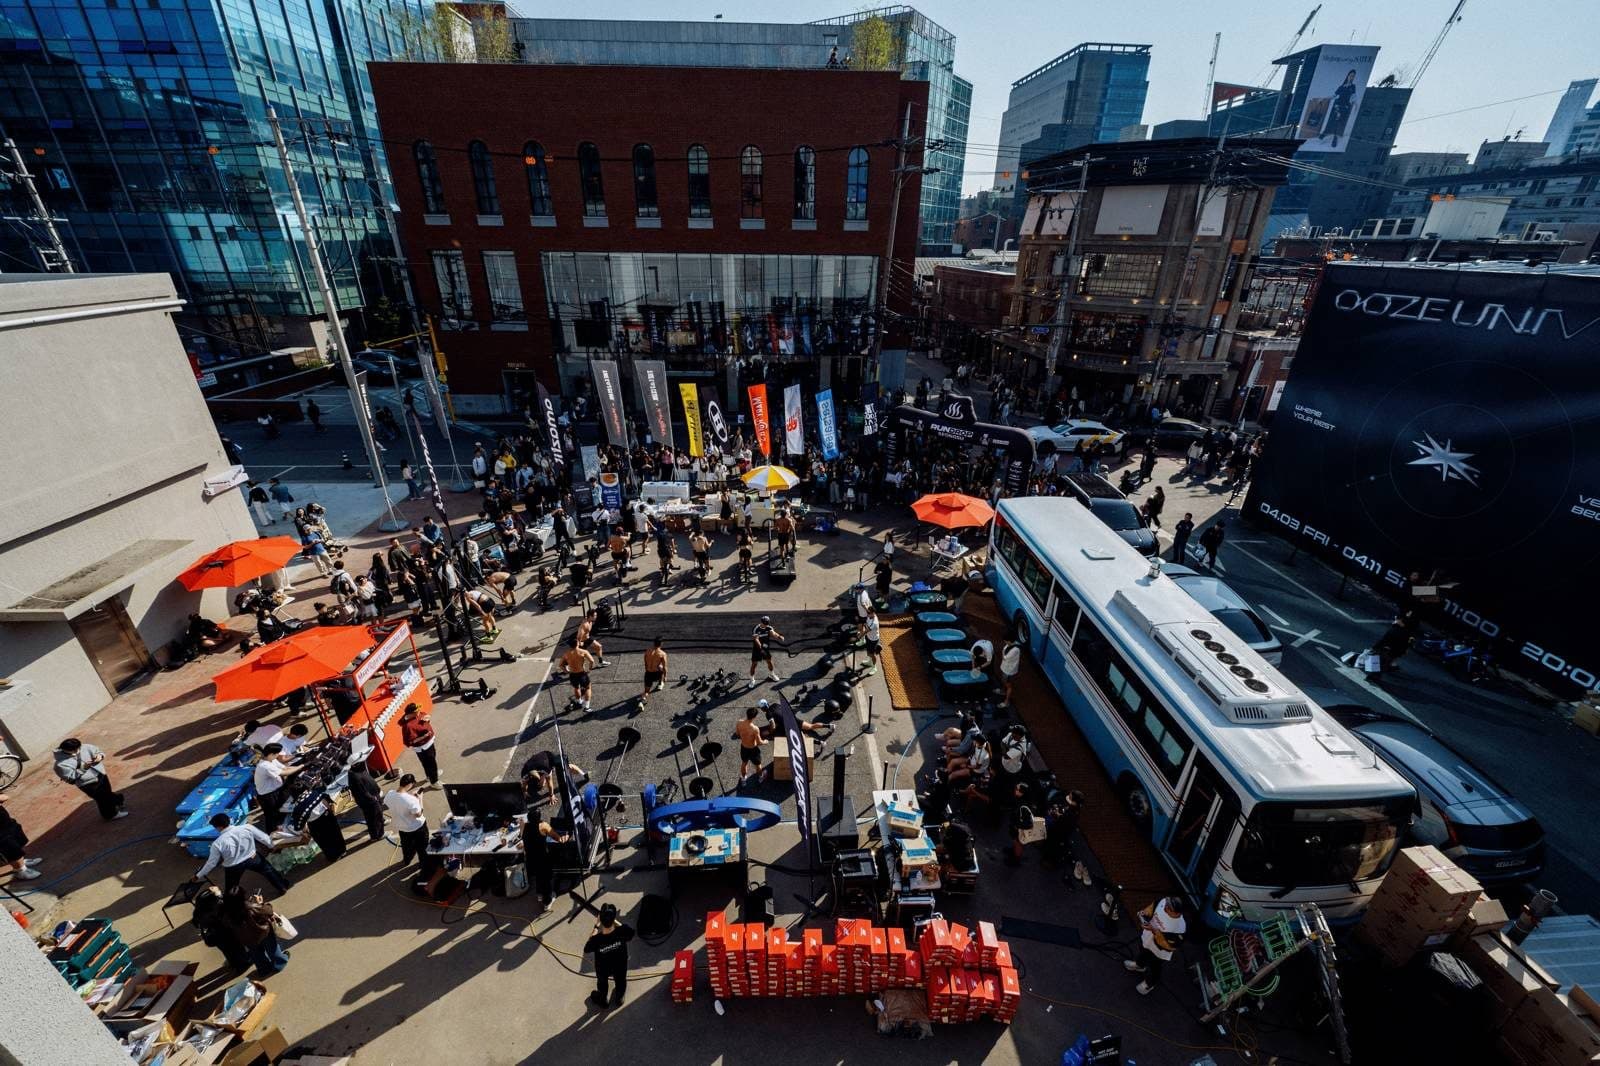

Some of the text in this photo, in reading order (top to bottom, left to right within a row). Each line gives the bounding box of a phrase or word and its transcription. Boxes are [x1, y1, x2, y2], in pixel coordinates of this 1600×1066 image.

[1260, 501, 1301, 532] 04.03
[1301, 524, 1331, 547] FRI
[1342, 545, 1382, 576] 04.11
[1519, 640, 1600, 690] 20:0
